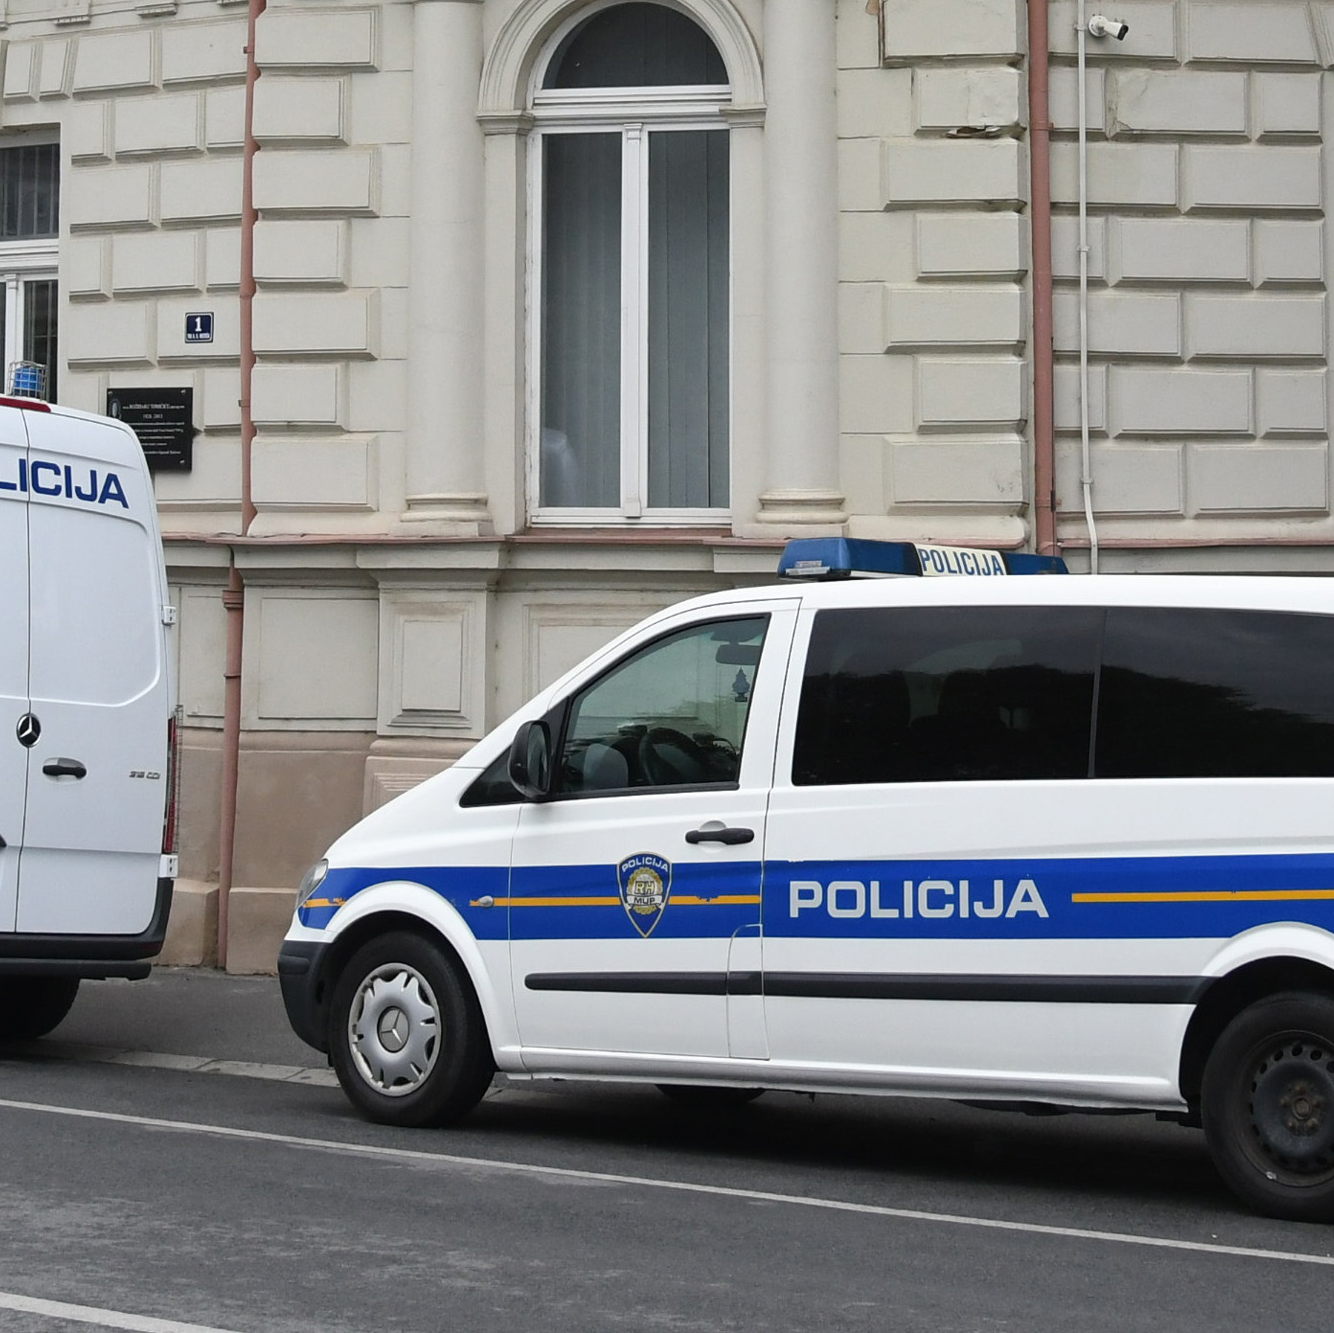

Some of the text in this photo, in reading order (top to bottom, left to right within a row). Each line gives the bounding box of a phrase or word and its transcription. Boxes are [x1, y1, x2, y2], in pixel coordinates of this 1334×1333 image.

[195, 316, 203, 332] 1
[920, 548, 1005, 576] POLICIJA
[621, 856, 669, 873] POLICIJA
[789, 879, 1050, 918] POLICIJA
